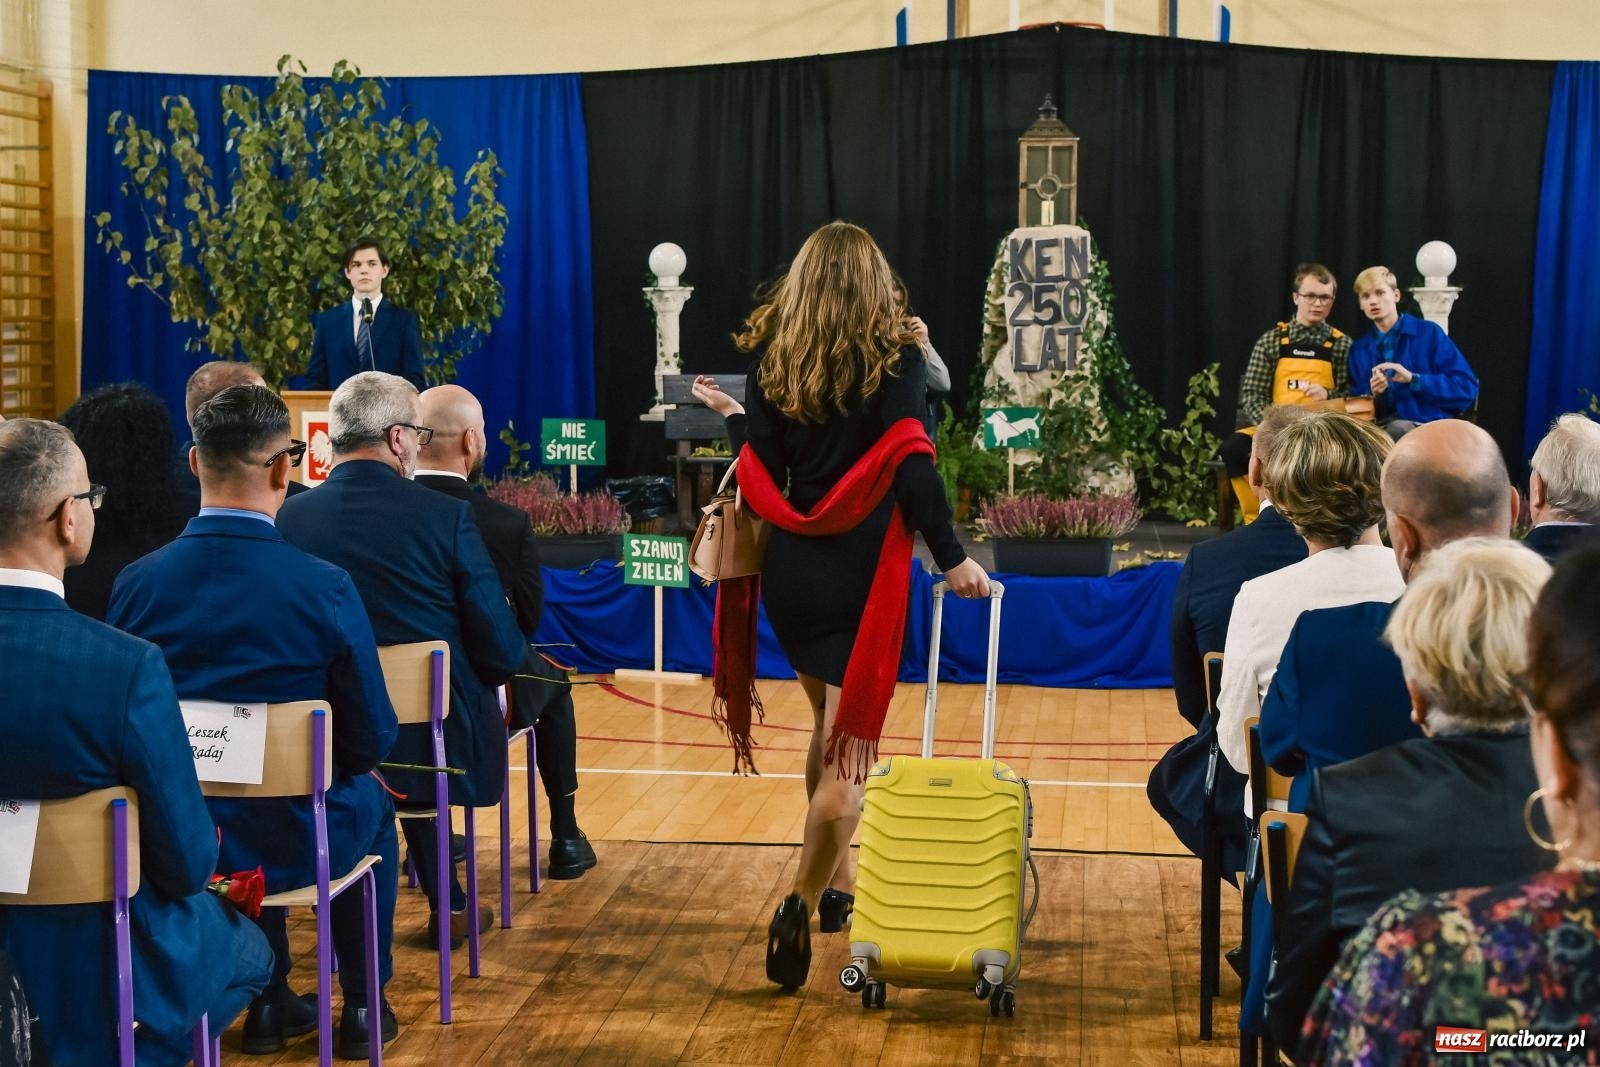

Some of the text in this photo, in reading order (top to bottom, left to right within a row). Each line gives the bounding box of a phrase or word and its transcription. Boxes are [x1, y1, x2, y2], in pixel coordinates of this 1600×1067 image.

[1009, 236, 1089, 282] KEN
[1008, 281, 1088, 326] 250
[1013, 325, 1083, 372] LAT
[561, 422, 586, 439] NIE
[546, 439, 596, 461] ŚMIEĆ
[630, 539, 683, 560] SZANUJ
[632, 561, 683, 581] ZIELEŃ
[187, 725, 230, 742] Leszek
[191, 745, 224, 762] Radaj
